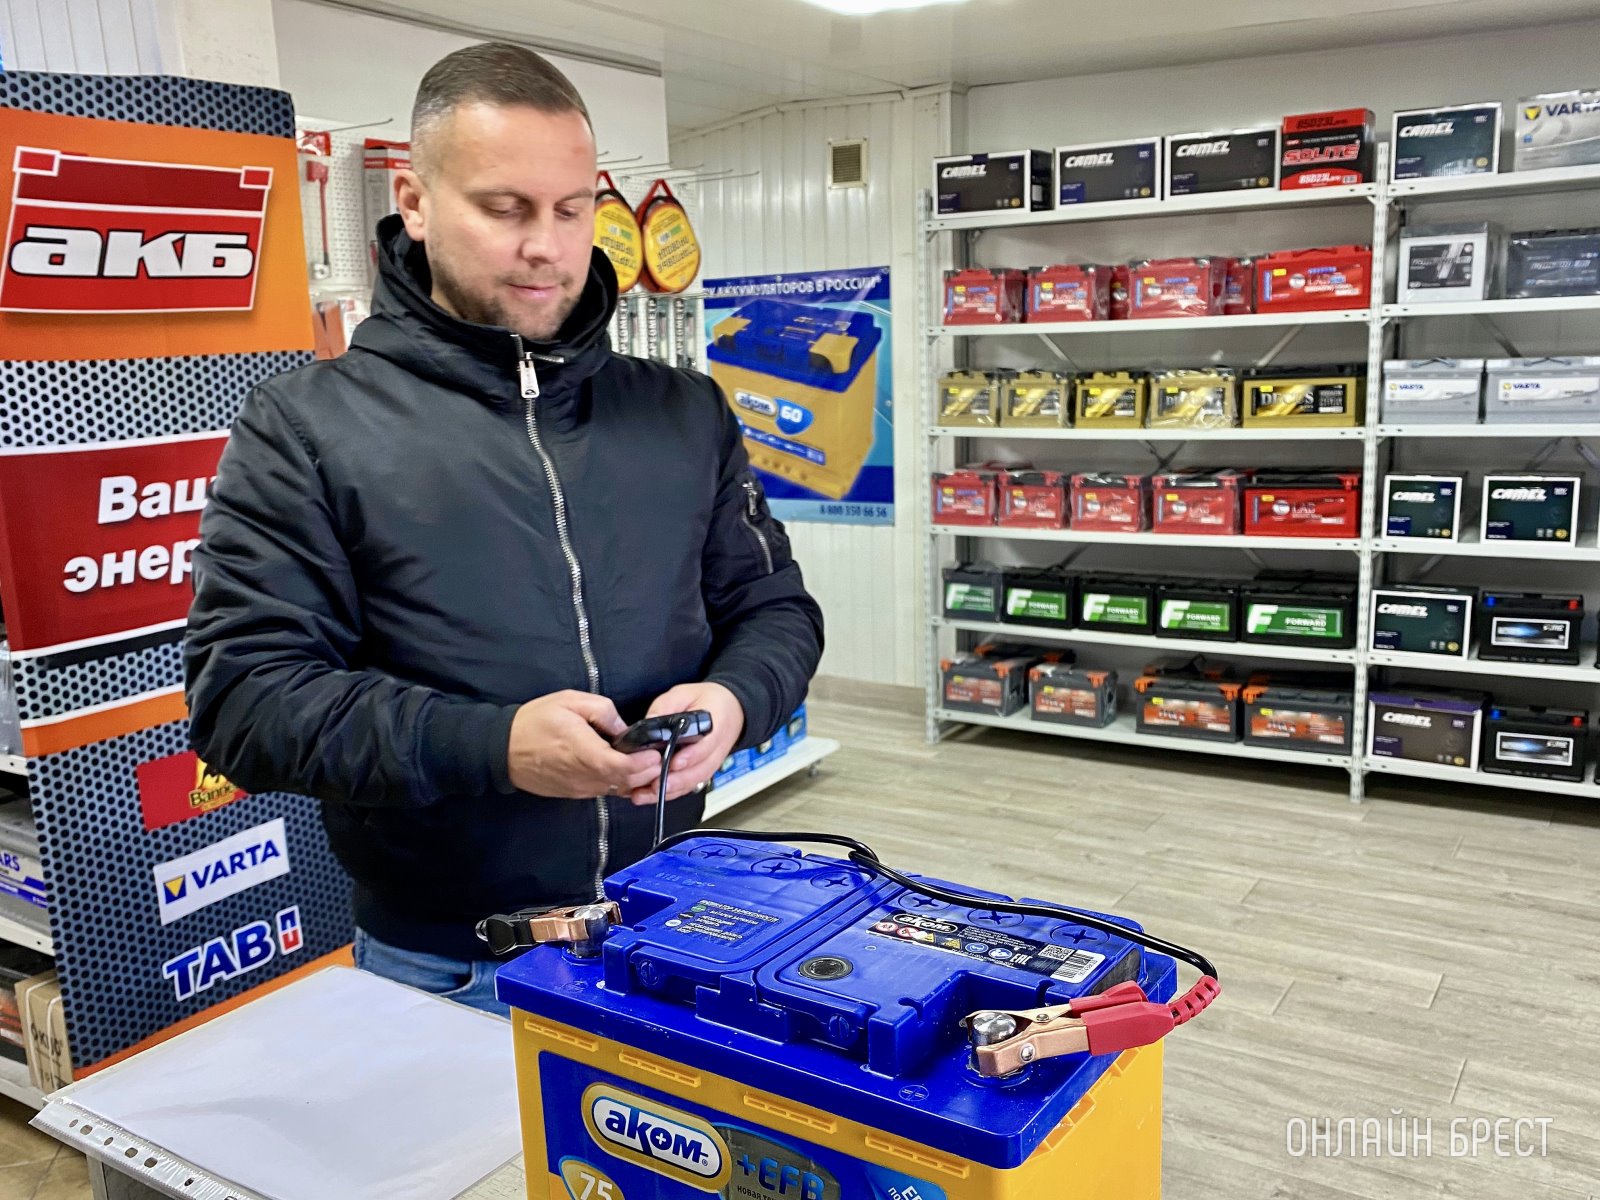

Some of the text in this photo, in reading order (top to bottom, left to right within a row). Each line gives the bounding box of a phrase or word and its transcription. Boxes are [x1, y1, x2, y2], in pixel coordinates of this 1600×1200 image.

[1400, 121, 1455, 138] CAMEL
[1176, 140, 1231, 157] CAMEL
[1065, 152, 1115, 168] CAMEL
[941, 164, 987, 179] CAMEL
[619, 299, 628, 355] АРЕОМЕТР
[648, 299, 657, 357] АРЕОМЕТР
[676, 300, 685, 356] АРЕОМЕТР
[781, 405, 803, 423] 60
[1392, 491, 1436, 503] CAMEL
[1491, 487, 1547, 502] CAMEL
[1106, 606, 1139, 616] FORWARD
[1186, 613, 1221, 622] FORWARD
[1377, 603, 1428, 617] CAMEL
[1285, 617, 1327, 627] FORWARD
[191, 840, 281, 889] VARTA
[163, 921, 276, 1001] TAB
[579, 1171, 613, 1200] 75
